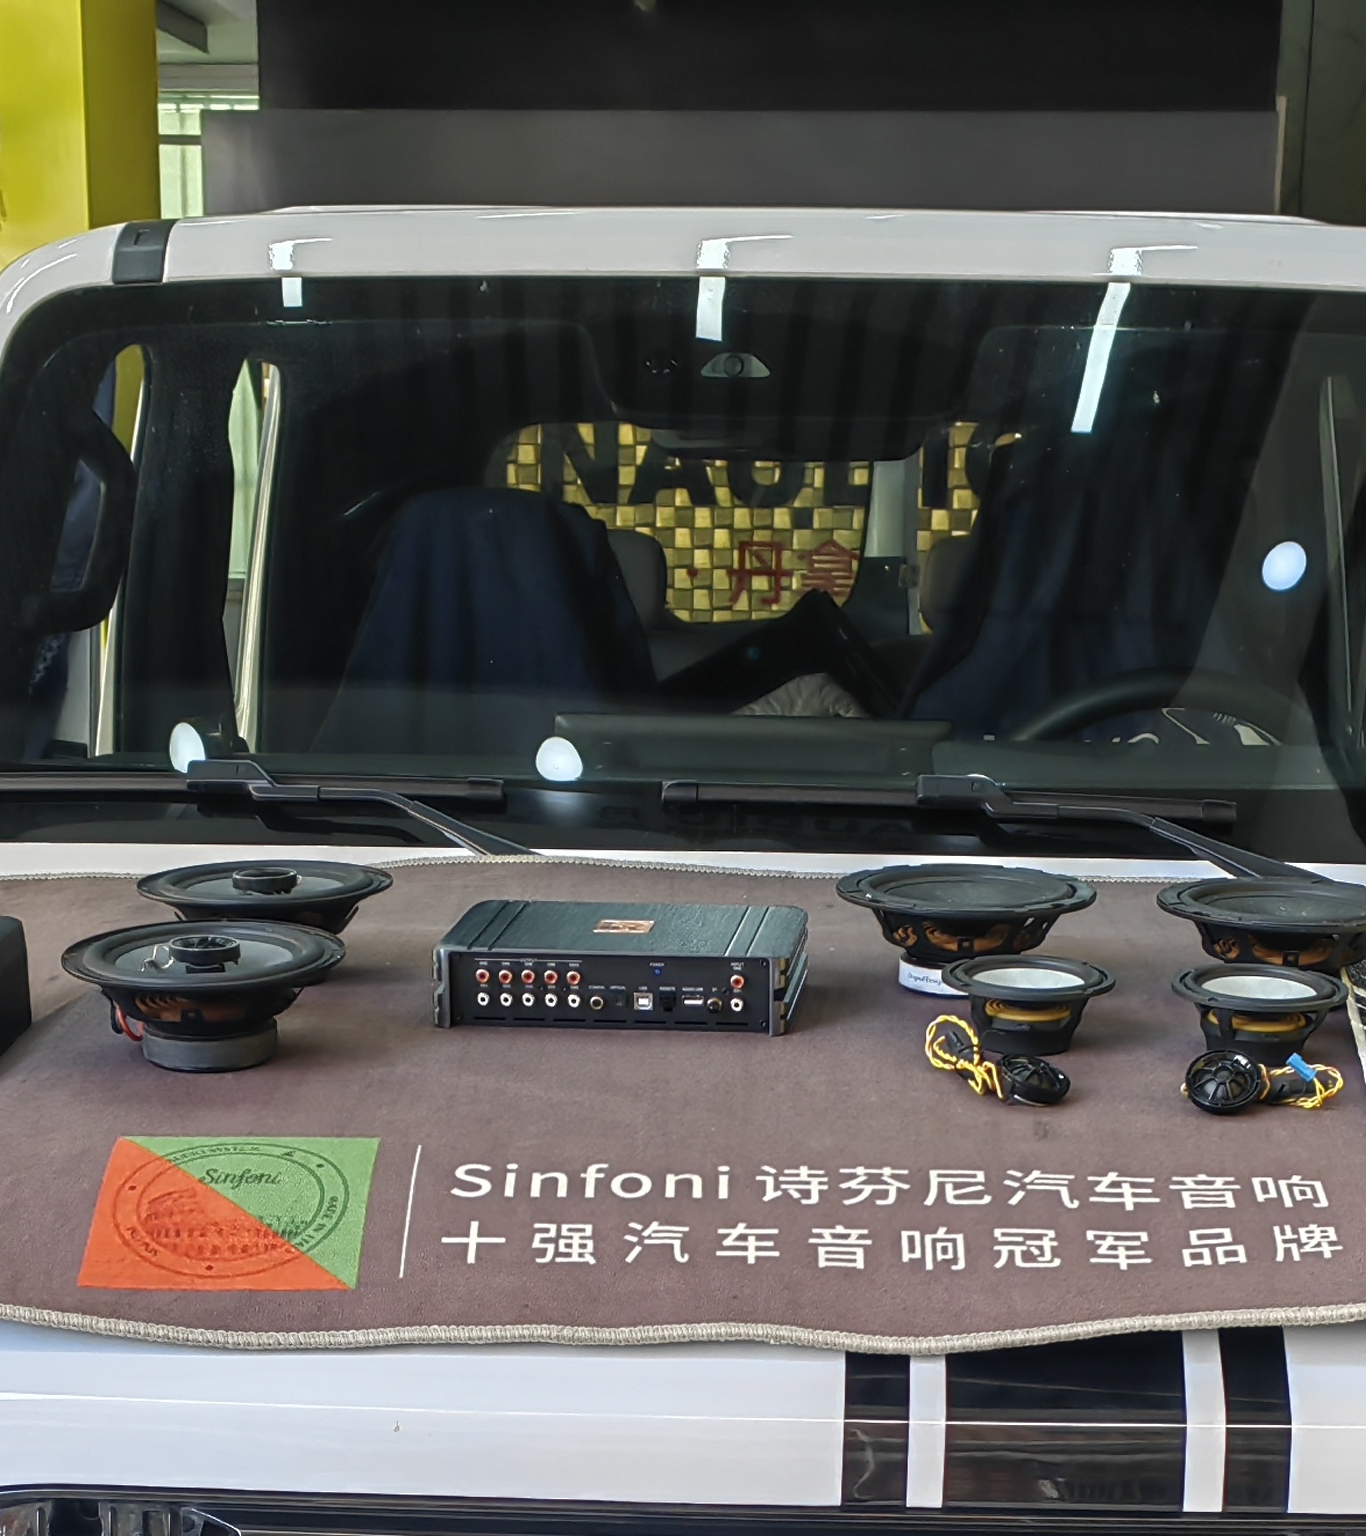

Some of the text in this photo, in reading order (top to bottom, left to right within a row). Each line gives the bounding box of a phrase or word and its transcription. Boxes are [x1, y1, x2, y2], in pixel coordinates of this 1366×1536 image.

[199, 1168, 282, 1190] Sinfoni
[450, 1163, 1330, 1211] Sinfoni 诗芬尼汽车音响
[441, 1220, 1344, 1271] 十强汽车音响冠军品牌
